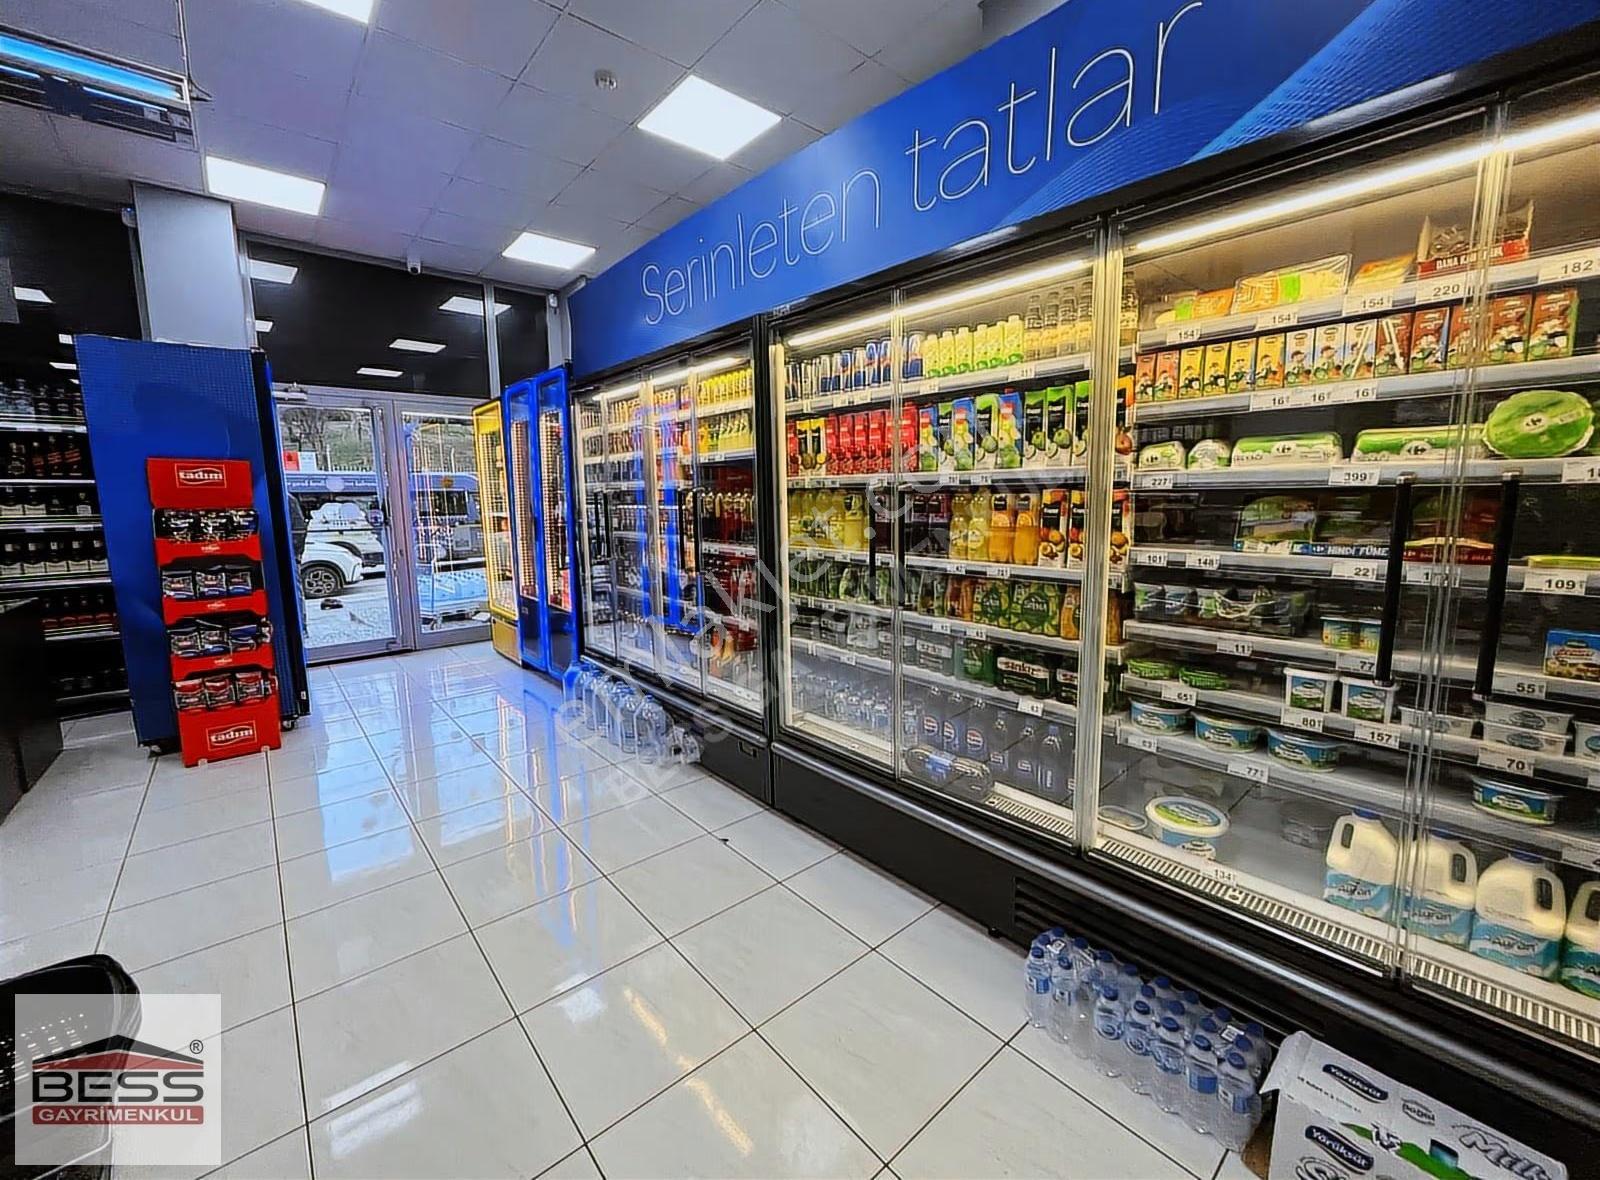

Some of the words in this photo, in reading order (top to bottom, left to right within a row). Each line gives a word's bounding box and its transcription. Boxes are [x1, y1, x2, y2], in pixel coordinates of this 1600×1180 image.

[640, 168, 881, 326] Serinleten
[904, 1, 1204, 213] tatlar
[1562, 260, 1594, 275] 182
[1432, 284, 1461, 297] 220
[1359, 297, 1385, 309] 154
[1271, 314, 1293, 325] 154
[1178, 330, 1196, 341] 154
[178, 470, 223, 481] tadım
[1544, 579, 1575, 590] 109
[1515, 682, 1536, 694] 55
[210, 728, 254, 743] tadım
[1368, 731, 1391, 743] 157
[1504, 758, 1525, 772] 70
